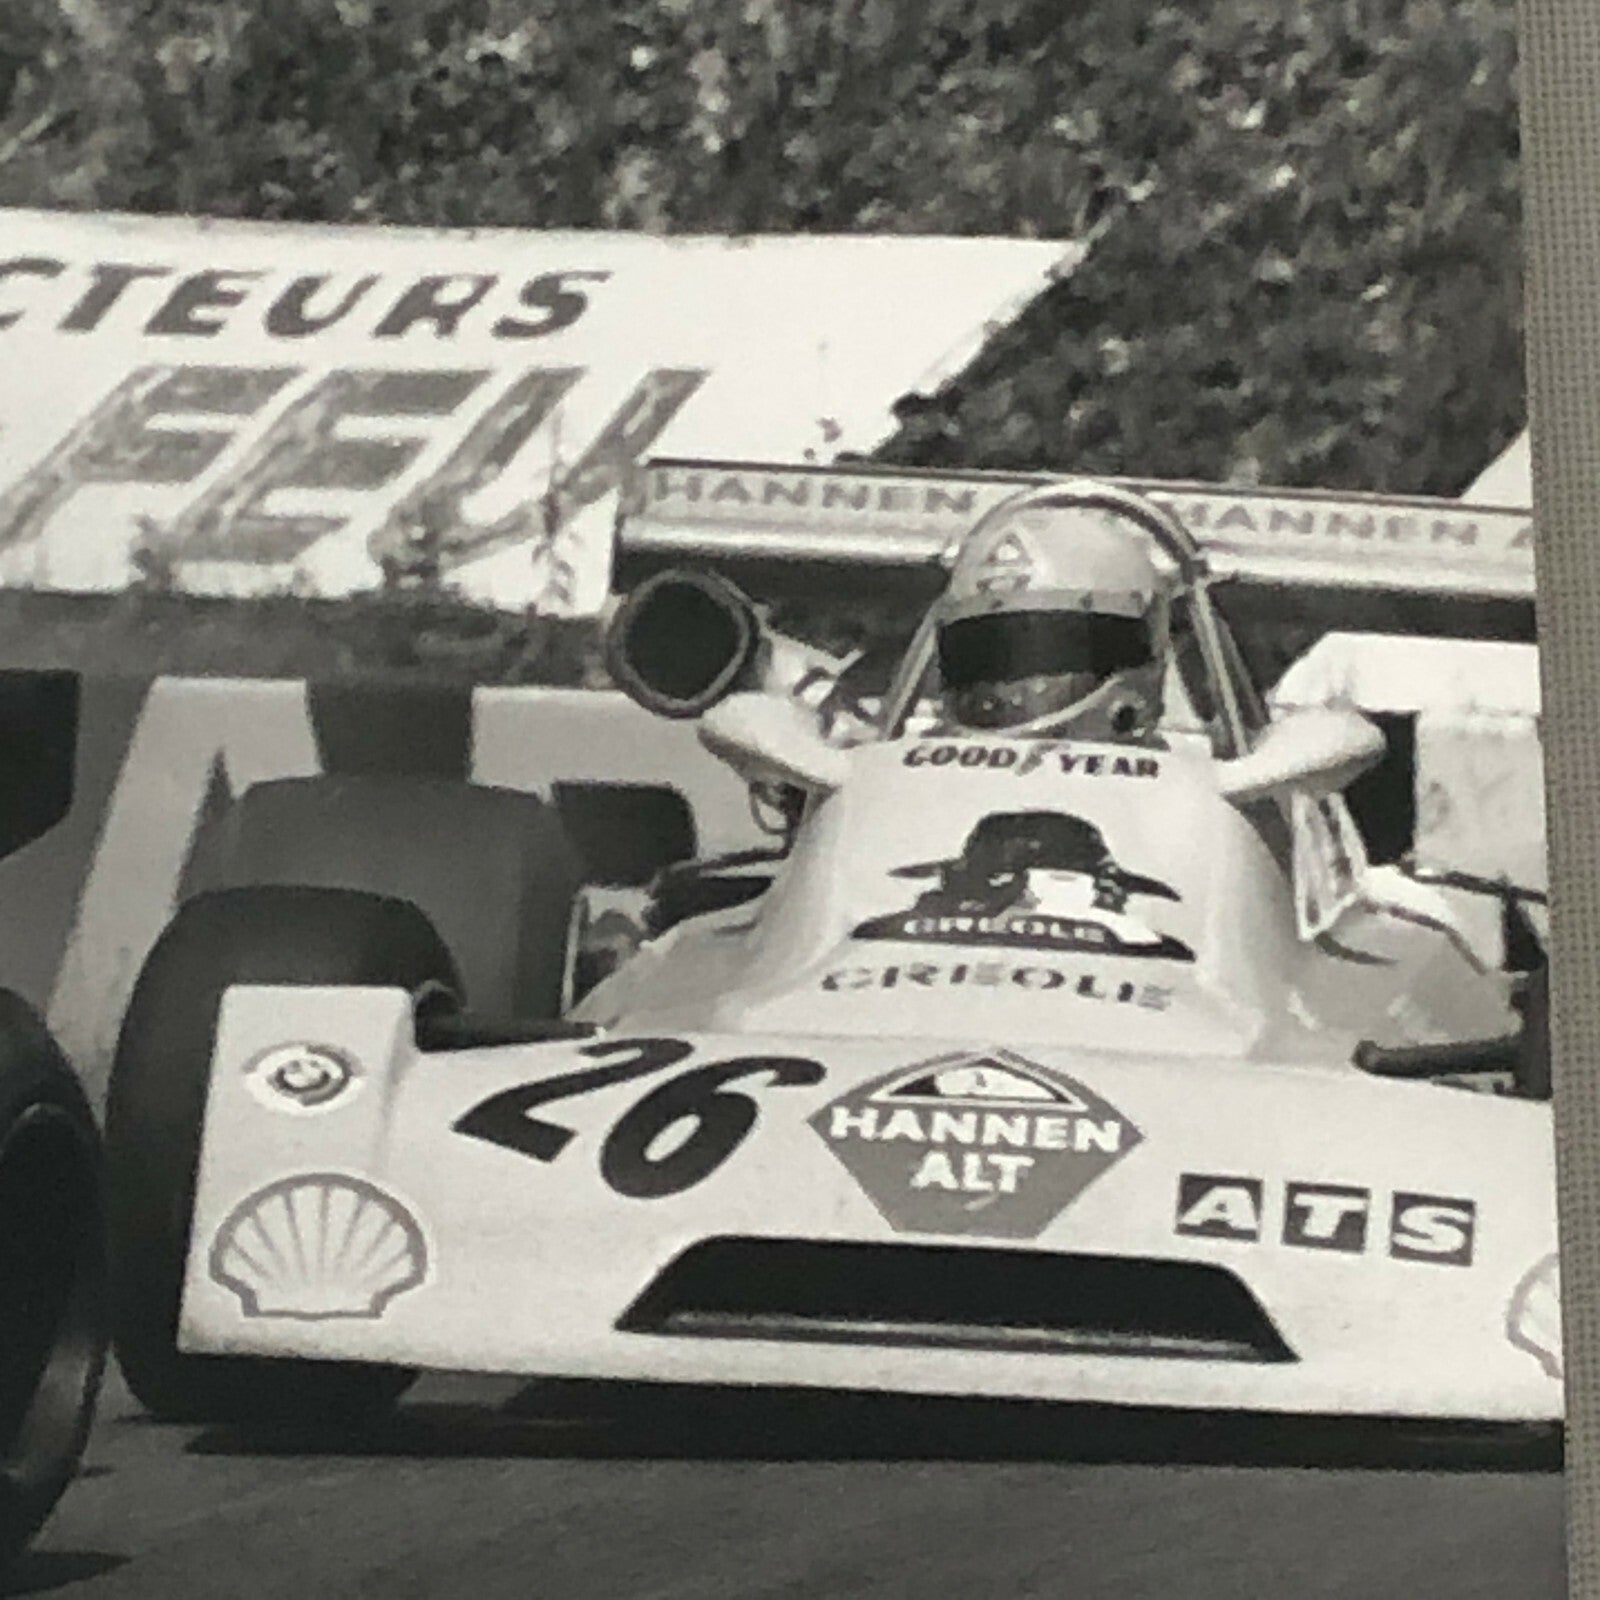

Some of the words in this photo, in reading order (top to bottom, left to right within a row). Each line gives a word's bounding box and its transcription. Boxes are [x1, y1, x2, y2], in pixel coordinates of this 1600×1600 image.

[655, 471, 978, 514] HANNEN
[902, 745, 1019, 769] GOOD
[1059, 752, 1160, 778] YEAR
[452, 1037, 828, 1200] 26
[830, 1106, 1122, 1153] HANNEN
[909, 1150, 1036, 1194] ALT
[1176, 1182, 1475, 1256] ATS
